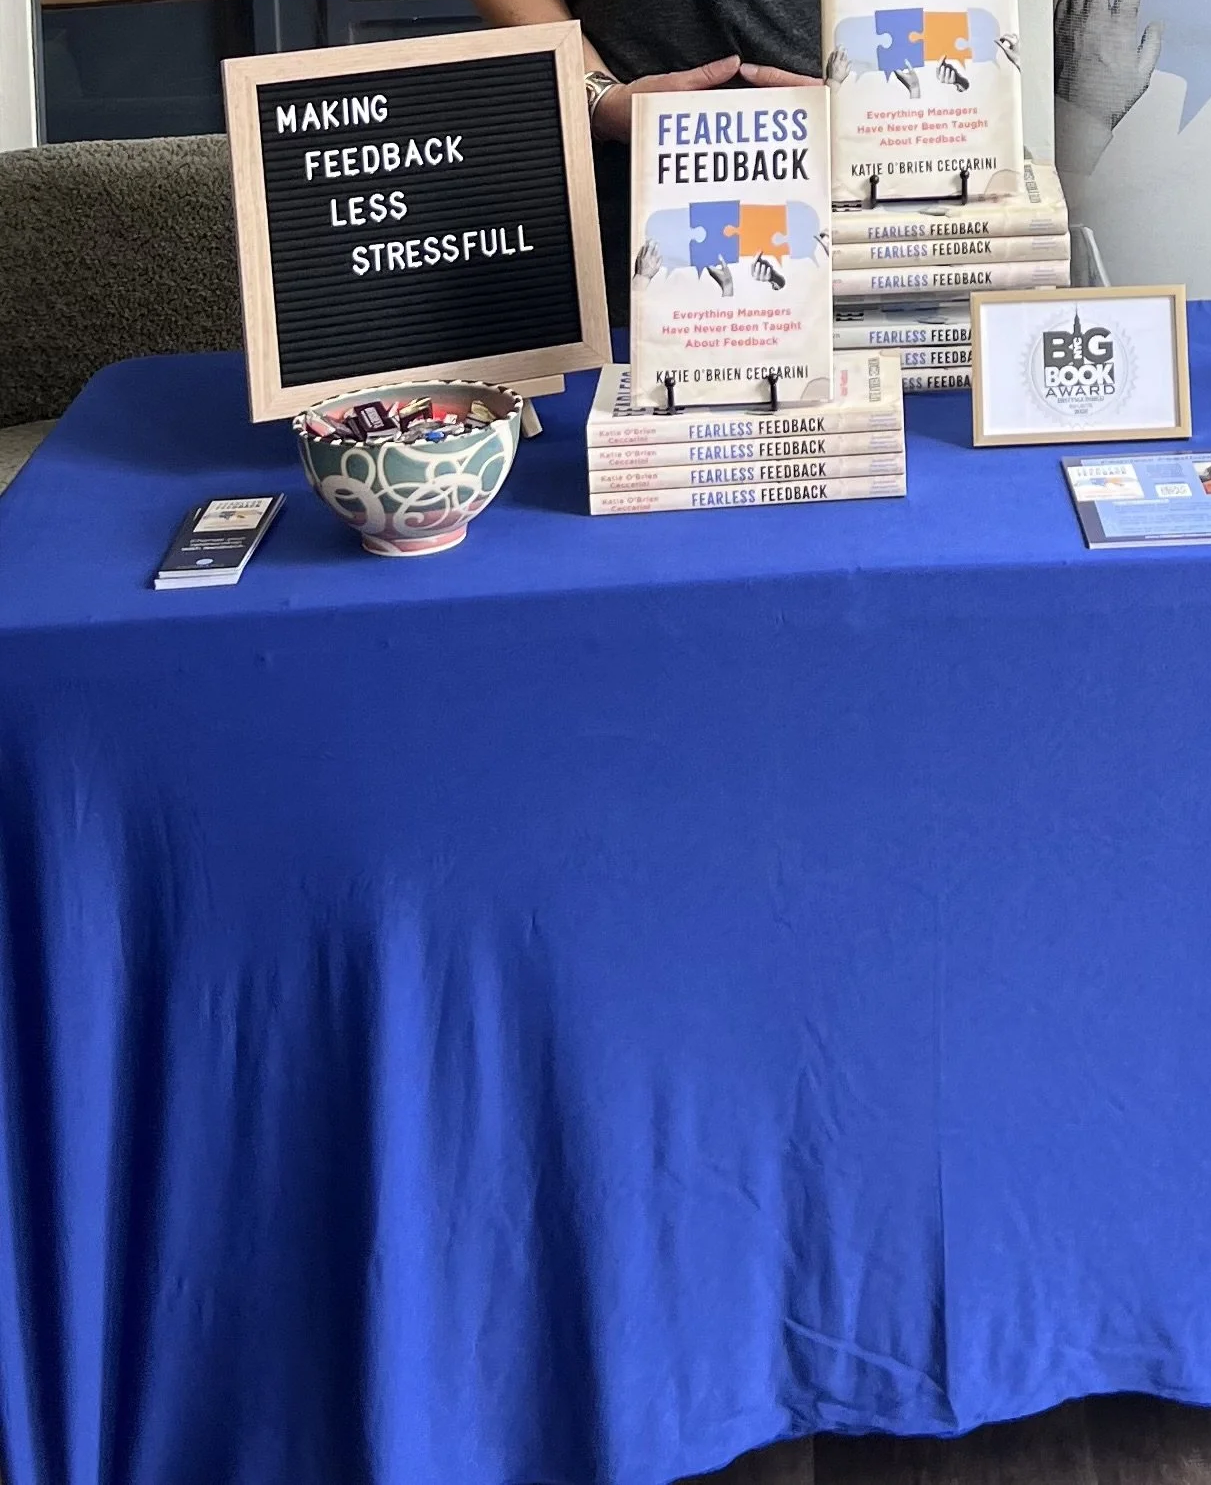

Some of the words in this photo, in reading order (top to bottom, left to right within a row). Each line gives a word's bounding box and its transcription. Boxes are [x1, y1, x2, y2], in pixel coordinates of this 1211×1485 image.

[275, 94, 388, 134] MAKING
[866, 108, 924, 120] Everything
[927, 106, 978, 118] Managers
[658, 108, 808, 146] FEARLESS
[857, 125, 884, 134] Have
[887, 124, 918, 132] Never
[921, 122, 949, 131] Been
[951, 119, 988, 130] Taught
[879, 137, 912, 147] About
[915, 133, 967, 144] Feedback
[305, 135, 464, 181] FEEDBACK
[658, 148, 810, 184] FEEDBACK
[851, 162, 883, 177] KATIE
[887, 160, 933, 175] O'BRIEN
[937, 157, 997, 172] CECCARINI
[330, 191, 408, 227] LESS
[867, 225, 926, 240] FEARLESS
[930, 221, 989, 236] FEEDBACK
[352, 224, 534, 276] STRESSFULL
[870, 245, 928, 260] FEARLESS
[932, 241, 992, 256] FEEDBACK
[871, 275, 928, 289] FEARLESS
[932, 271, 992, 286] FEEDBACK
[673, 309, 734, 321] Everything
[737, 307, 792, 318] Managers
[662, 325, 690, 334] Have
[694, 324, 728, 333] Never
[731, 323, 759, 332] Been
[762, 321, 802, 331] Taught
[869, 330, 927, 344] FEARLESS
[685, 339, 720, 348] About
[723, 336, 779, 347] Feedback
[901, 353, 926, 366] ESS
[656, 369, 689, 384] KATIE
[694, 367, 741, 382] O'BRIEN
[746, 365, 809, 380] CECCARINI
[1045, 362, 1115, 387] BOOK
[1045, 384, 1116, 398] AWARD
[688, 422, 753, 440] FEARLESS
[758, 416, 825, 435] FEEDBACK
[689, 444, 754, 462] FEARLESS
[759, 439, 826, 457] FEEDBACK
[690, 466, 755, 485] FEARLESS
[760, 462, 827, 480] FEEDBACK
[691, 489, 756, 507] FEARLESS
[761, 484, 828, 503] FEEDBACK
